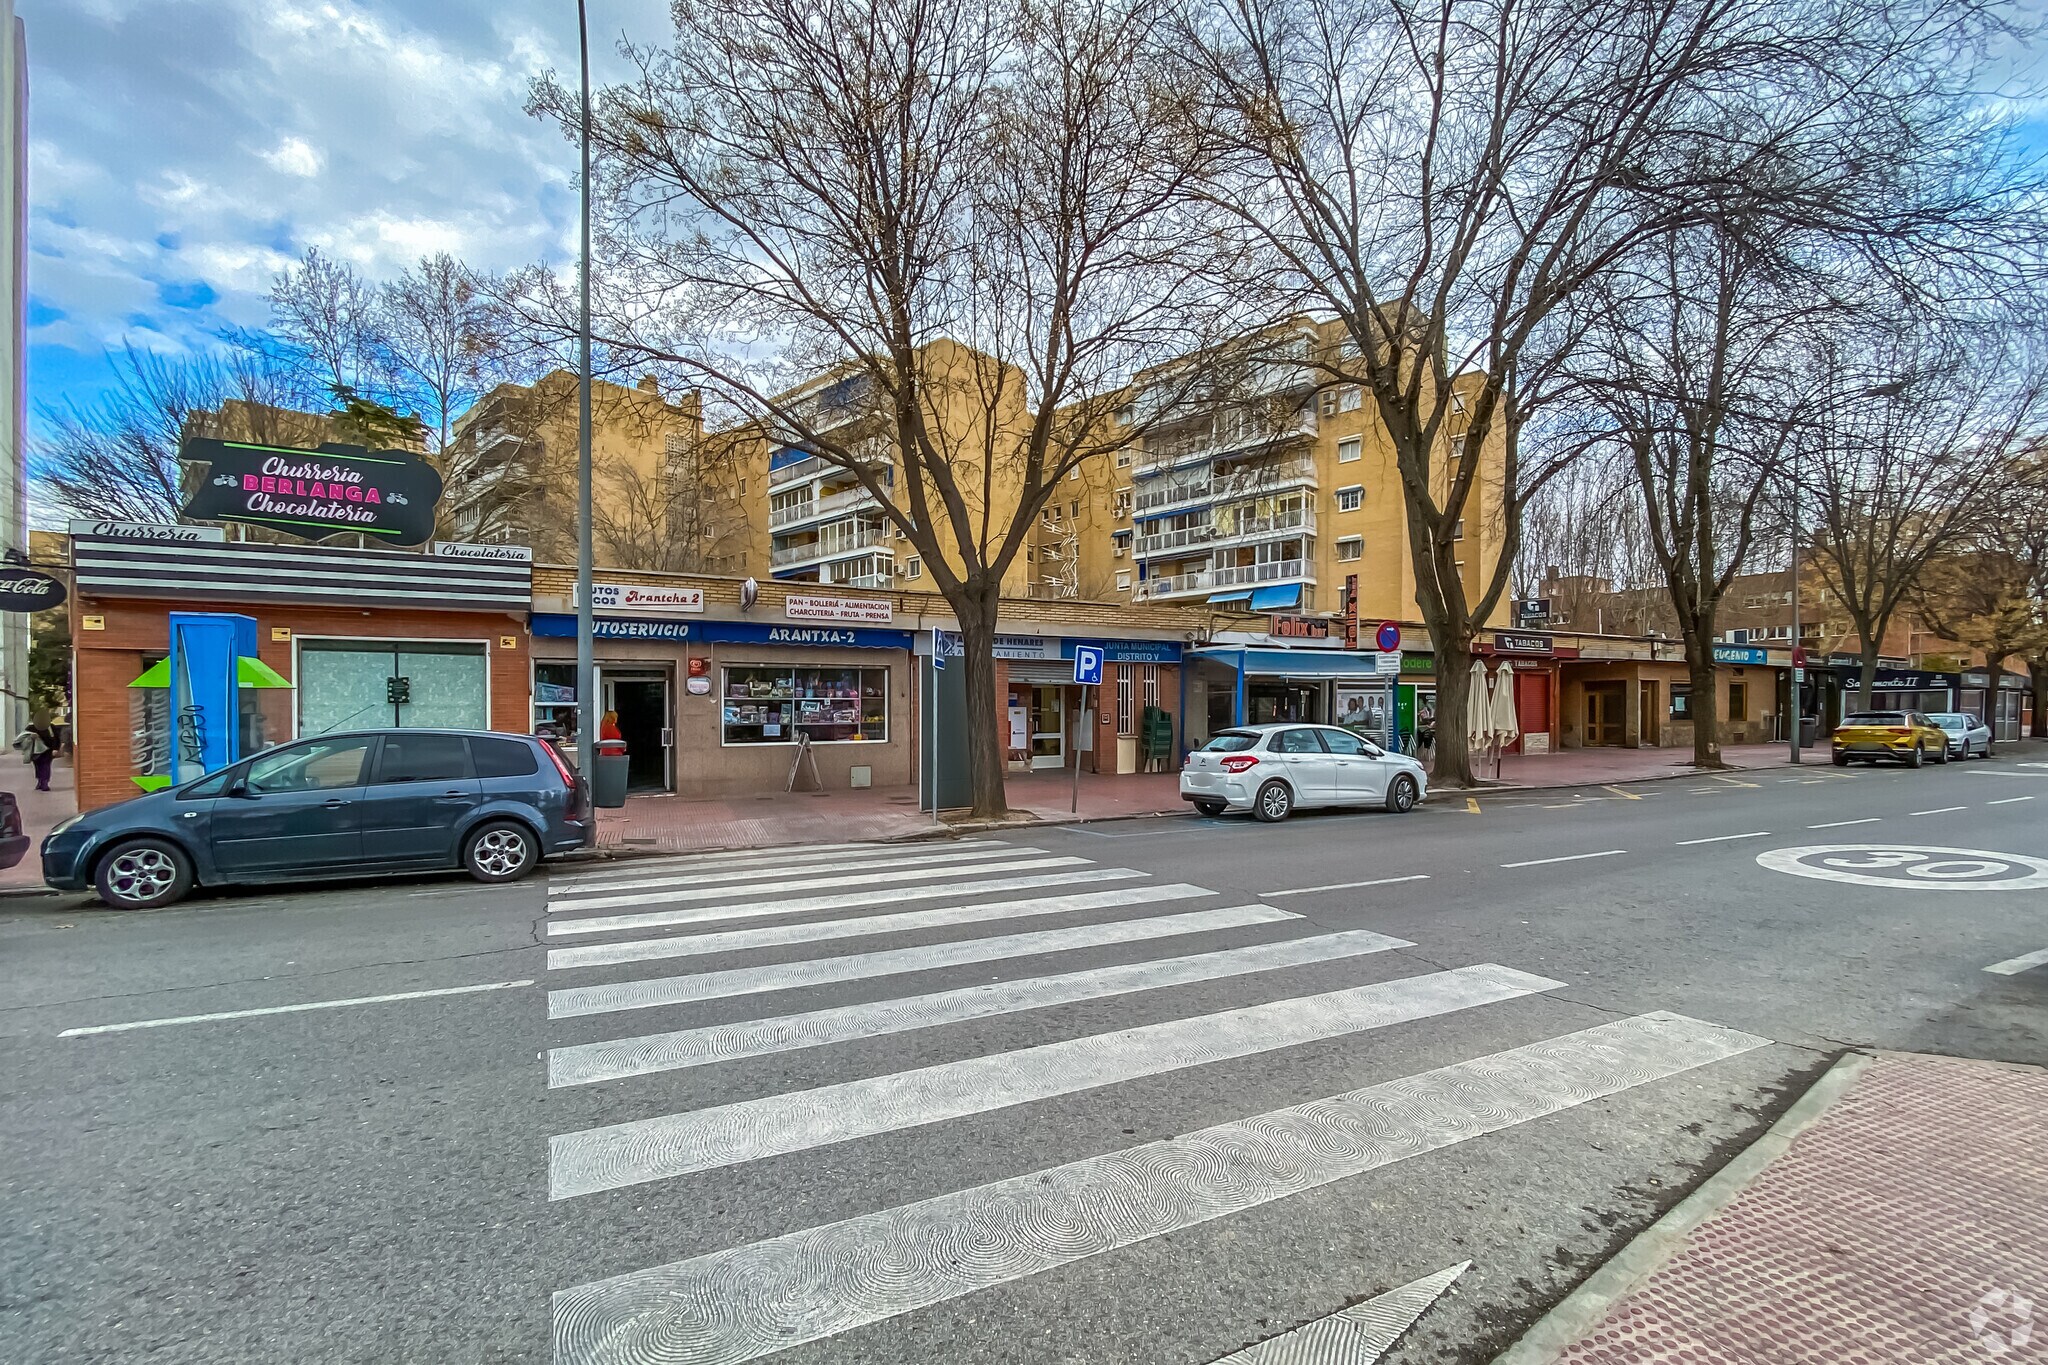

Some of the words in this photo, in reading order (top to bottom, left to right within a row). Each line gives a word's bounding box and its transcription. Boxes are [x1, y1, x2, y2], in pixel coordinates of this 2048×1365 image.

[262, 456, 364, 483] Churrería
[243, 474, 381, 504] BERLANGA
[247, 492, 377, 523] Chocolatería
[592, 597, 616, 605] COS
[625, 590, 687, 603] Arantcha
[691, 593, 700, 604] 2
[845, 602, 890, 610] ALIMENTACION
[789, 608, 834, 617] CHARCUTERIA
[866, 612, 889, 620] PRENSA
[1520, 611, 1547, 619] TABACOS
[592, 620, 689, 637] UTOSERVICIO
[1311, 624, 1327, 638] bar
[769, 627, 856, 643] ARANTXA-2
[993, 637, 1004, 645] DE
[1007, 638, 1044, 647] HENARES
[1104, 641, 1130, 651] JUNTA
[1130, 642, 1171, 652] MUNICIPAL
[1514, 639, 1544, 648] TABACOS
[1117, 652, 1152, 661] DISTRITO
[1153, 653, 1160, 661] V
[1714, 649, 1750, 661] EUGENIO
[1079, 651, 1097, 680] P
[1402, 657, 1432, 669] odere
[1823, 851, 2010, 878] 30
